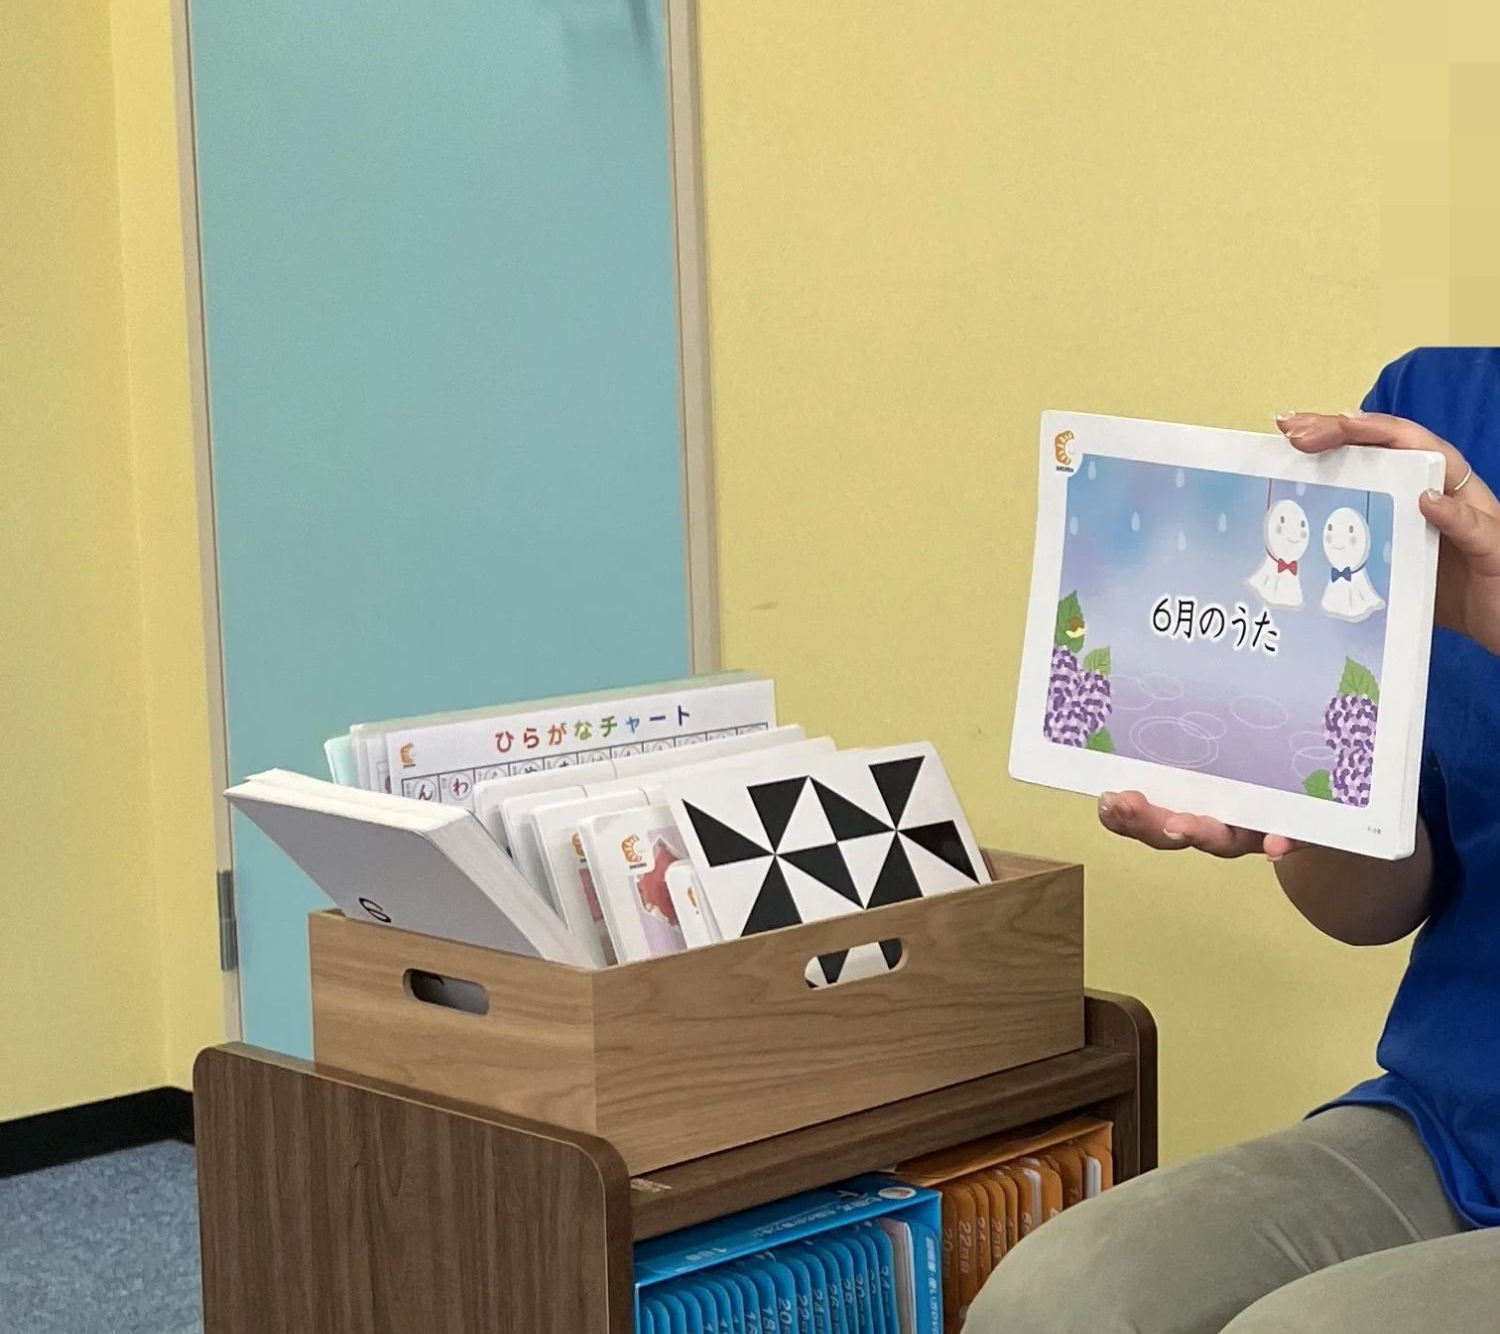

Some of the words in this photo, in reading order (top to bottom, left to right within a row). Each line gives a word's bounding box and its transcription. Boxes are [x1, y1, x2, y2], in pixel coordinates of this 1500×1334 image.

[1152, 598, 1280, 653] 6月のうた
[495, 705, 690, 754] ひらがなチャート
[452, 778, 469, 796] わ
